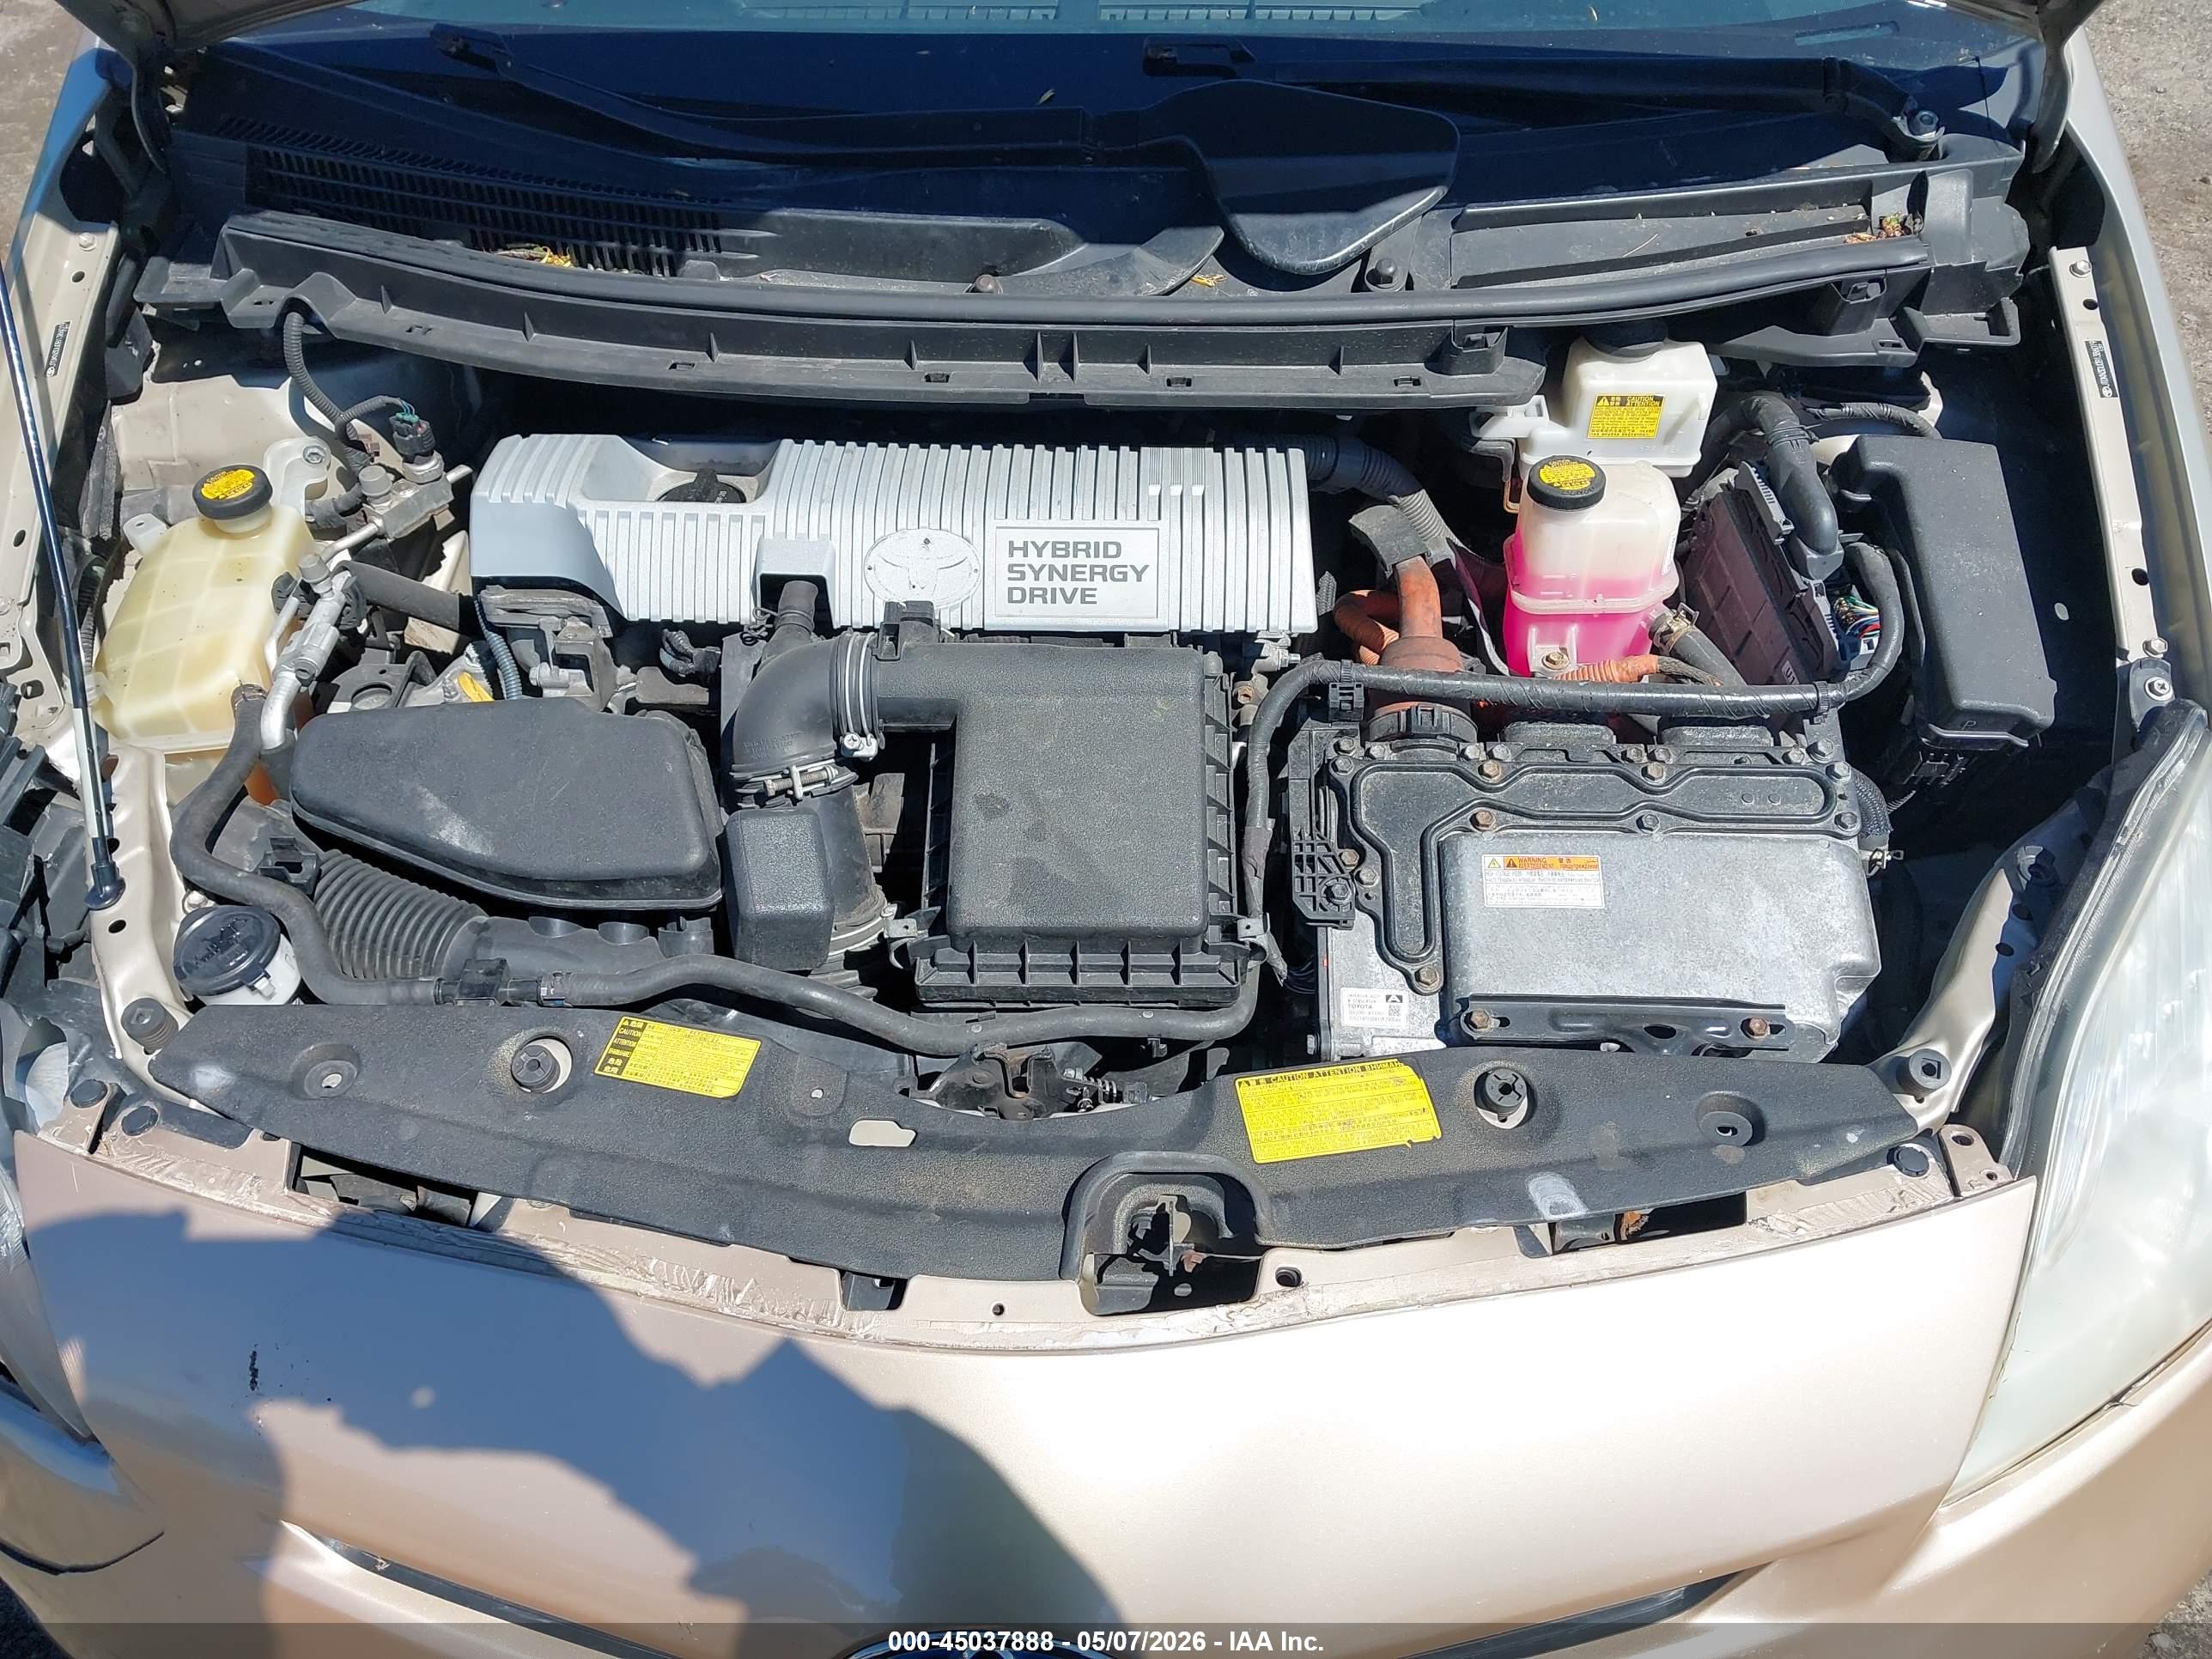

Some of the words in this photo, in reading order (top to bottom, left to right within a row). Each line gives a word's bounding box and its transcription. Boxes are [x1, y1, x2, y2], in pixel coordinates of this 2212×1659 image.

[1008, 540, 1122, 559] HYBRID
[1007, 563, 1150, 583] SYNERGY
[1007, 586, 1097, 605] DRIVE
[618, 1027, 643, 1037] CAUTION
[1271, 1072, 1309, 1084] CAUTION
[1314, 1066, 1361, 1079] ATTENTION
